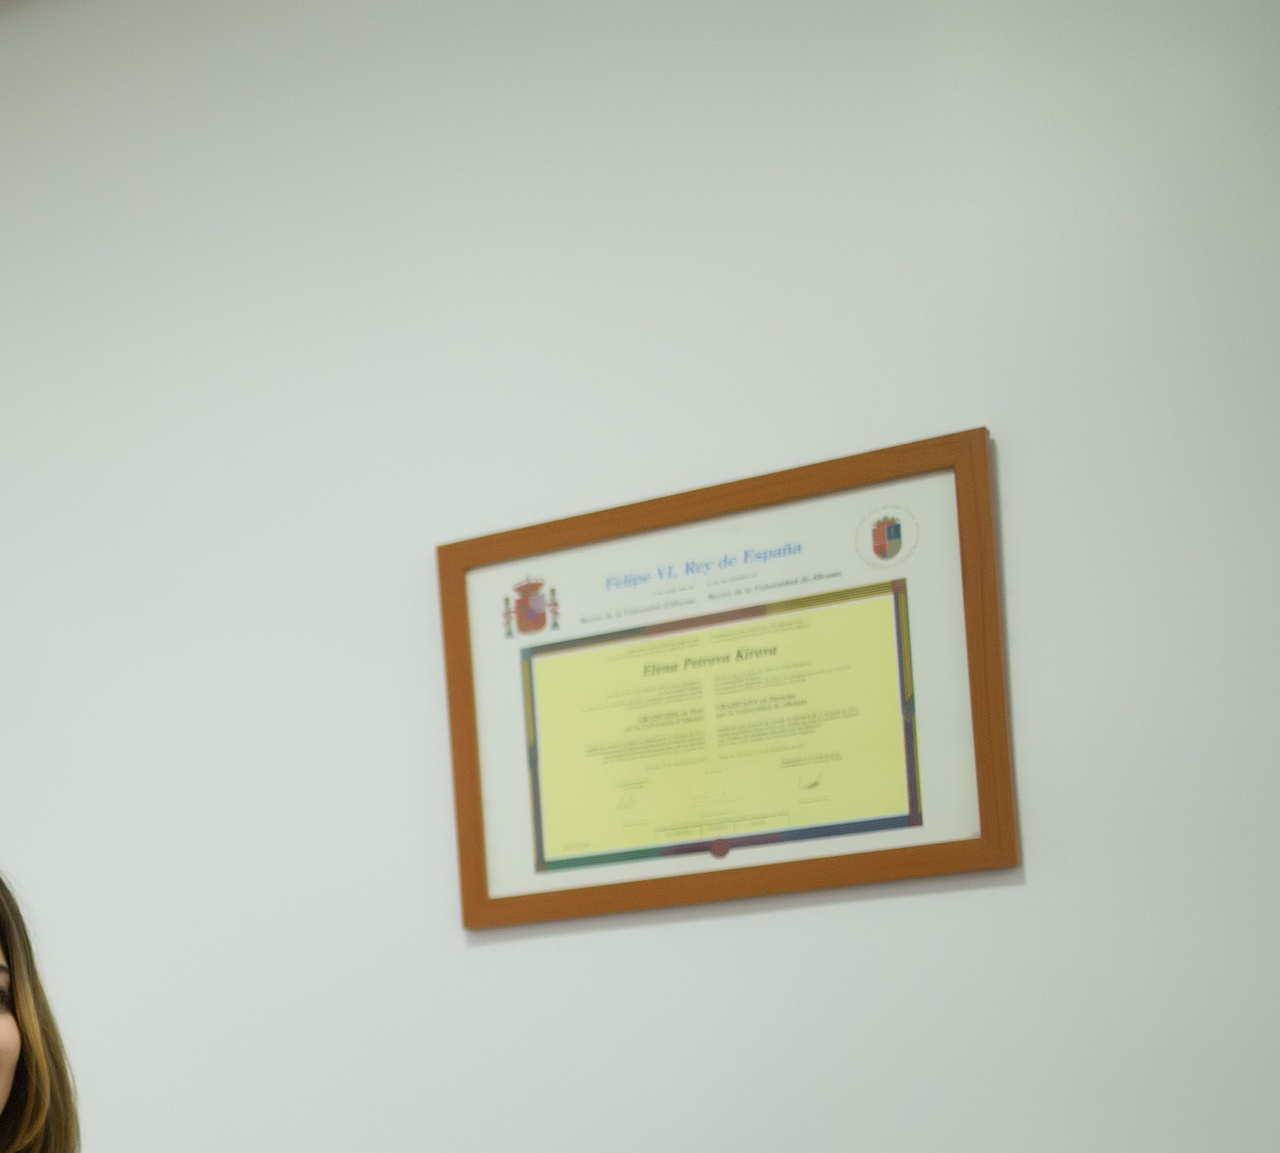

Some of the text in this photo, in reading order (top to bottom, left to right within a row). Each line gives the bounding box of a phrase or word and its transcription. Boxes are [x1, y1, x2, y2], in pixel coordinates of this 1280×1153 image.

[605, 571, 652, 591] Felipe
[684, 560, 714, 577] Rey
[718, 554, 738, 569] de
[743, 541, 802, 564] España
[642, 644, 778, 678] Elena Petrova Kirova
